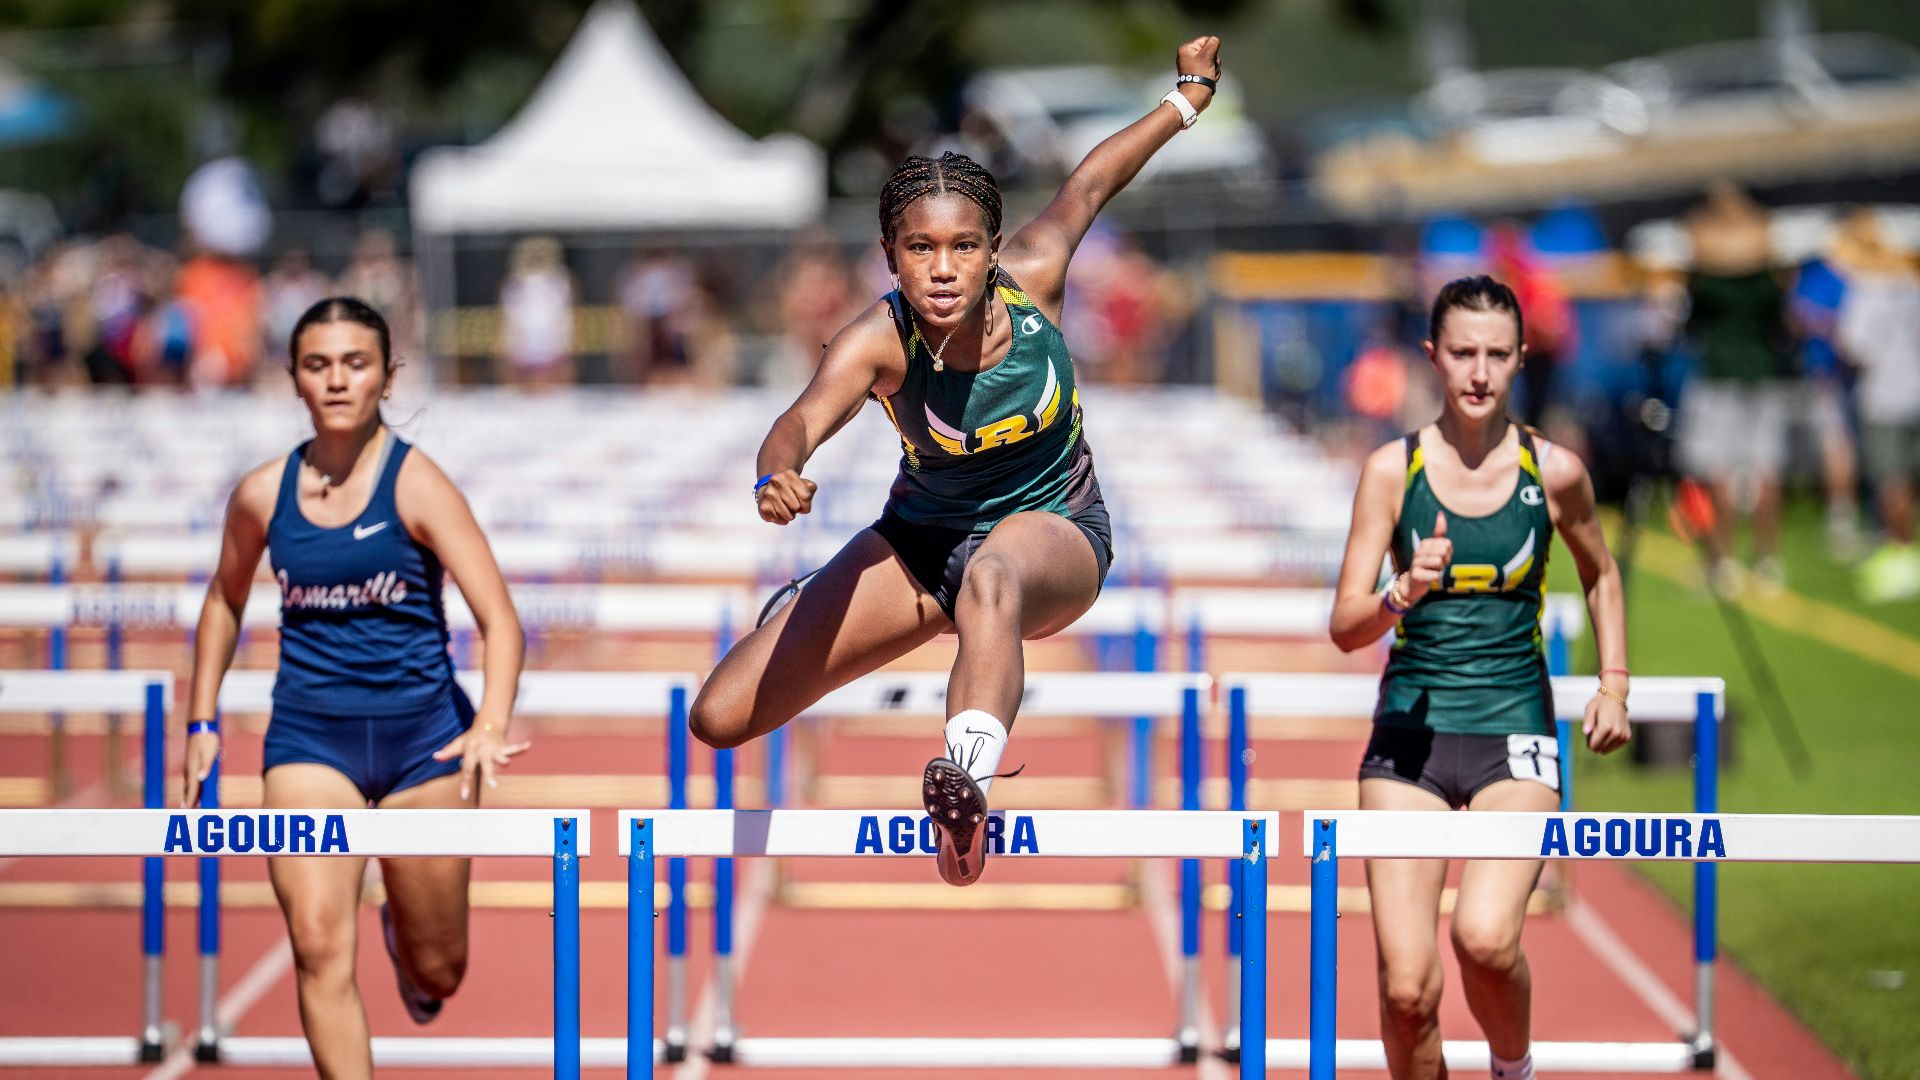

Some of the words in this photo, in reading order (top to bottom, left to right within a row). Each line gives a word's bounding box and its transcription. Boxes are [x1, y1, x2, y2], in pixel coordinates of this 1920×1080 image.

[973, 414, 1035, 453] R
[1446, 564, 1500, 593] R
[164, 815, 350, 853] AGOURA
[855, 815, 1040, 854] AGORA
[1540, 817, 1726, 858] AGOURA
